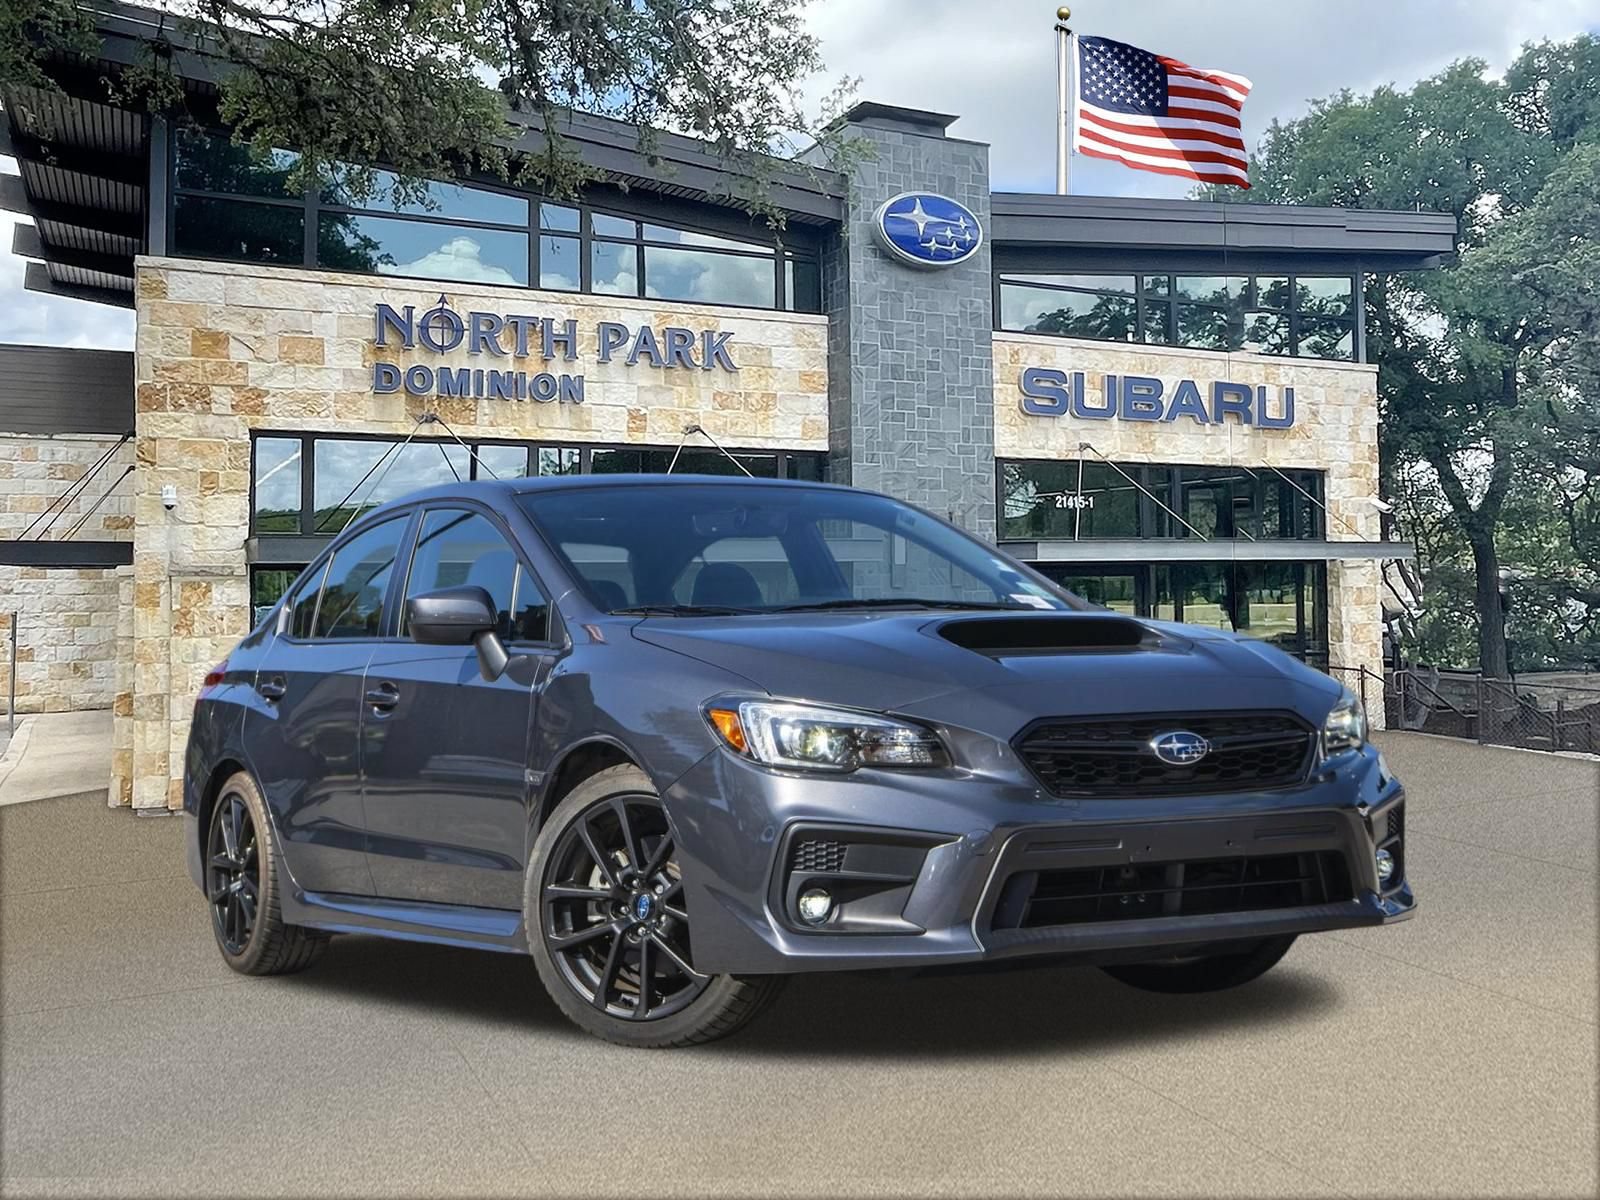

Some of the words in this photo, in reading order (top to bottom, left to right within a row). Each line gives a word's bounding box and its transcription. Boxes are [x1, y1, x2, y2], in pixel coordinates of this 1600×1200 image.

[374, 296, 579, 361] NORTH
[598, 321, 741, 372] PARK
[373, 362, 585, 404] DOMINION
[1019, 367, 1295, 430] SUBARU
